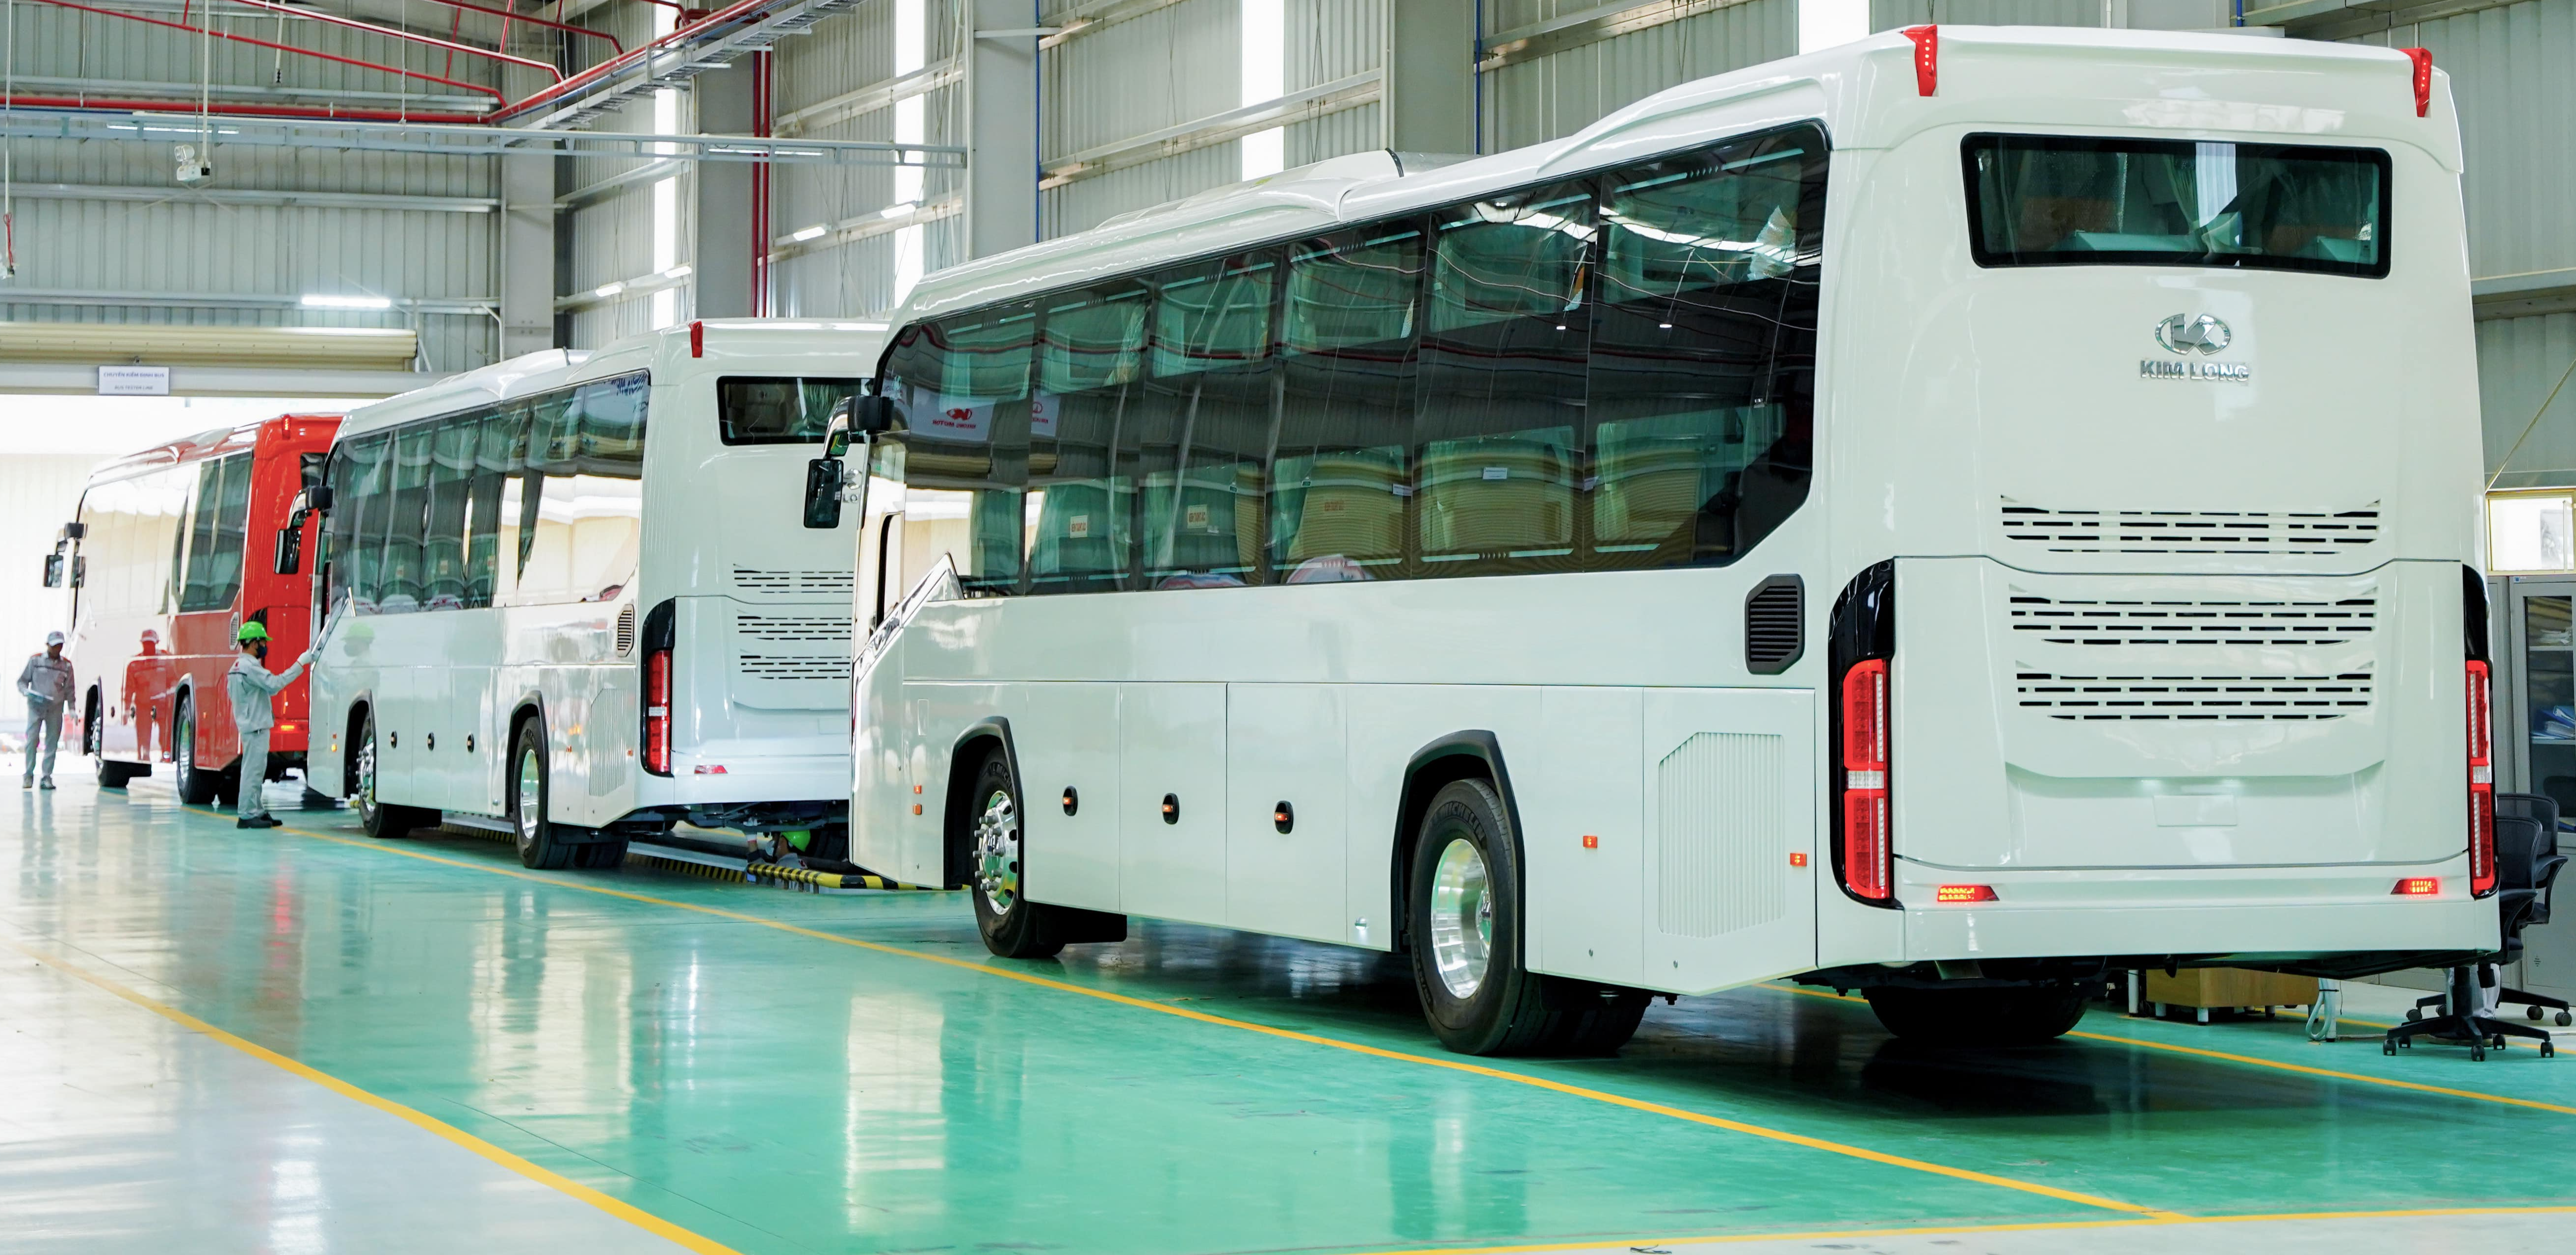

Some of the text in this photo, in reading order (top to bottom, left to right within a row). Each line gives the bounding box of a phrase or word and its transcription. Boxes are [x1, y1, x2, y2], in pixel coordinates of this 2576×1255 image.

[2140, 360, 2249, 382] KIM LONG
[842, 494, 859, 503] LO
